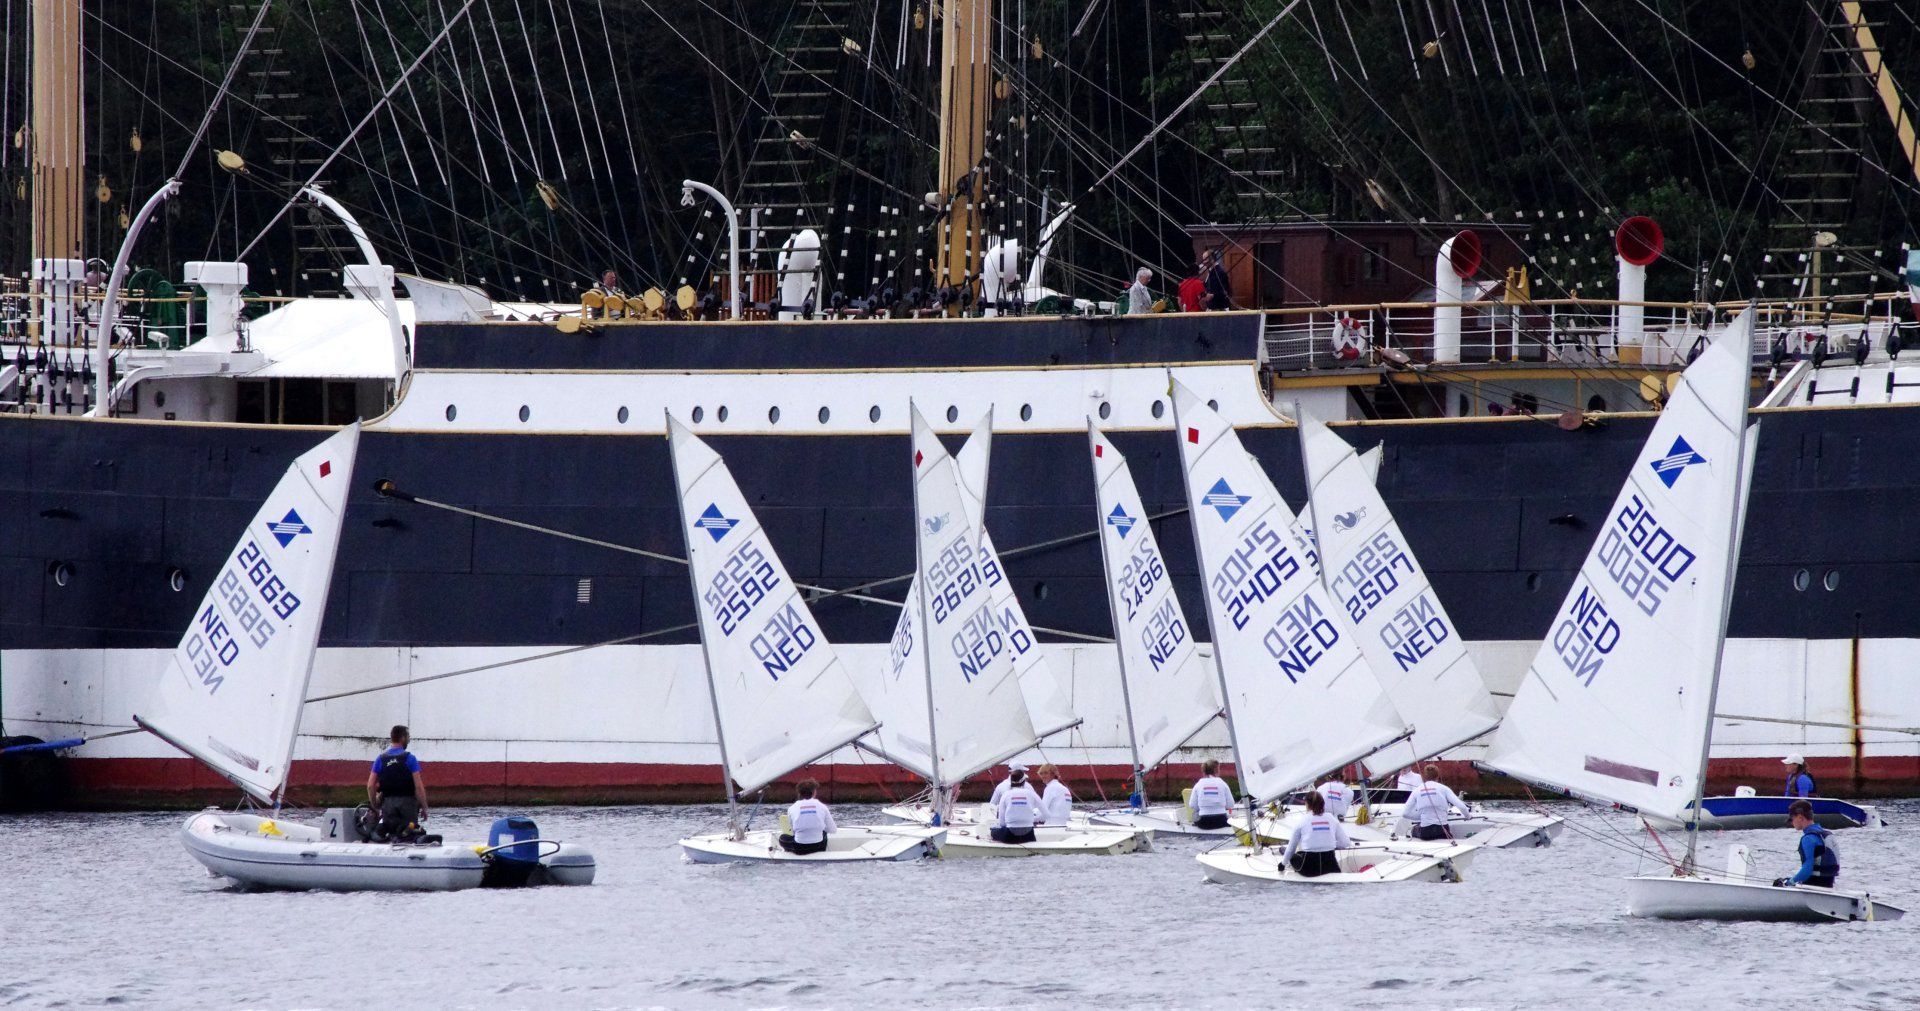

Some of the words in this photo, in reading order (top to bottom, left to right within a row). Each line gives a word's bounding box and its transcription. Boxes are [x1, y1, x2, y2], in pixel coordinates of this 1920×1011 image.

[1617, 494, 1696, 583] 2600
[237, 541, 301, 620] 2669
[716, 561, 780, 637] 2592
[931, 562, 982, 624] 2621
[1126, 557, 1163, 623] 2496
[1227, 546, 1300, 631] 2405
[1345, 552, 1415, 625] 2507
[199, 604, 239, 666] NED
[763, 624, 815, 681] NED
[1149, 619, 1185, 672] NED
[1278, 618, 1339, 684] NED
[1393, 617, 1448, 673] NED
[1569, 585, 1621, 655] NED
[959, 630, 1003, 683] NED
[330, 818, 337, 838] 2
